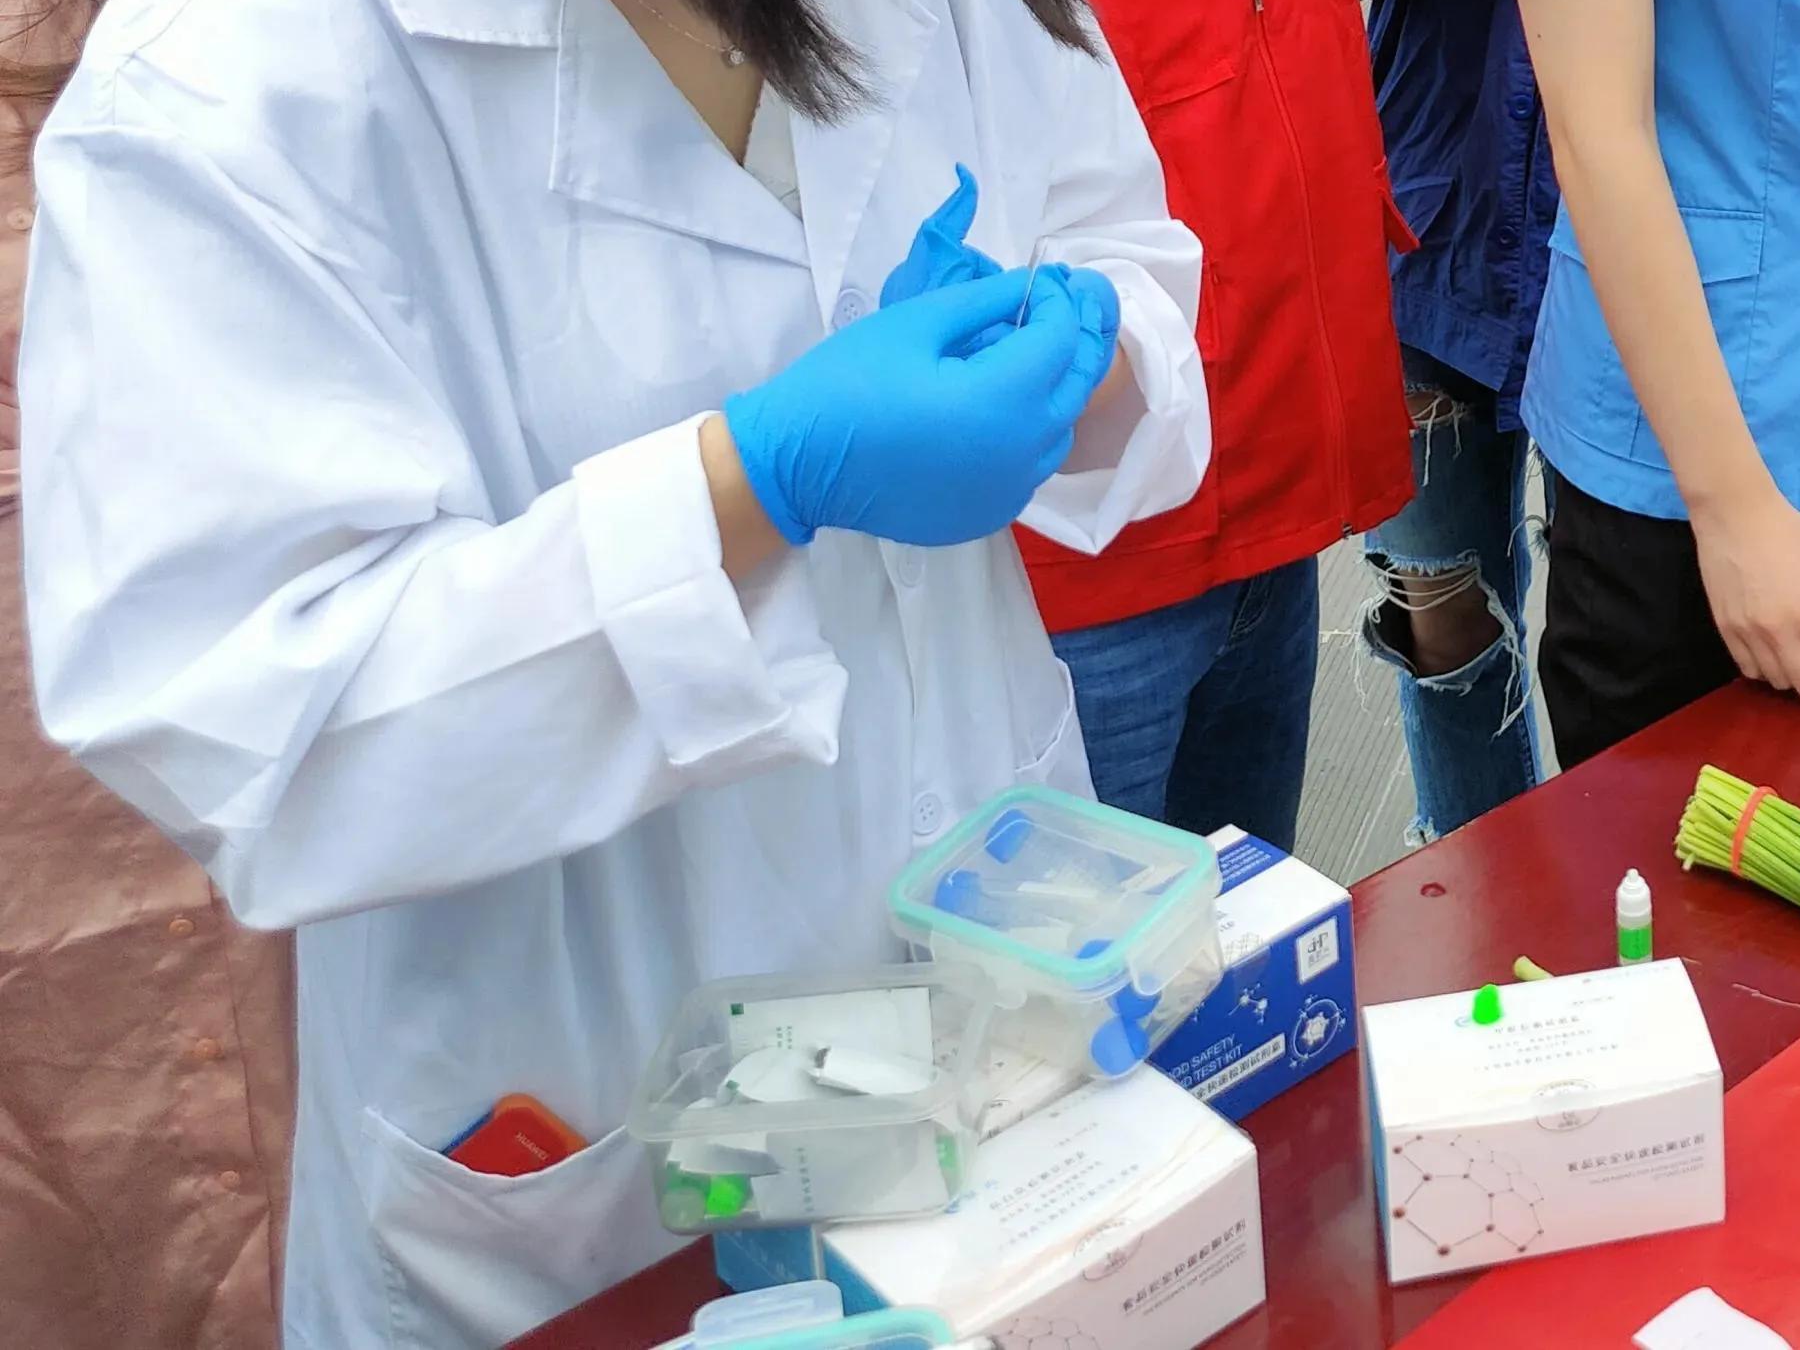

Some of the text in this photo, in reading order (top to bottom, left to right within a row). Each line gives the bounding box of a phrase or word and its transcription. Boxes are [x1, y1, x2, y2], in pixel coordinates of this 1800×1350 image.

[1192, 1033, 1237, 1069] SAFETY
[1196, 1057, 1226, 1084] TEST
[1224, 1042, 1245, 1060] KIT
